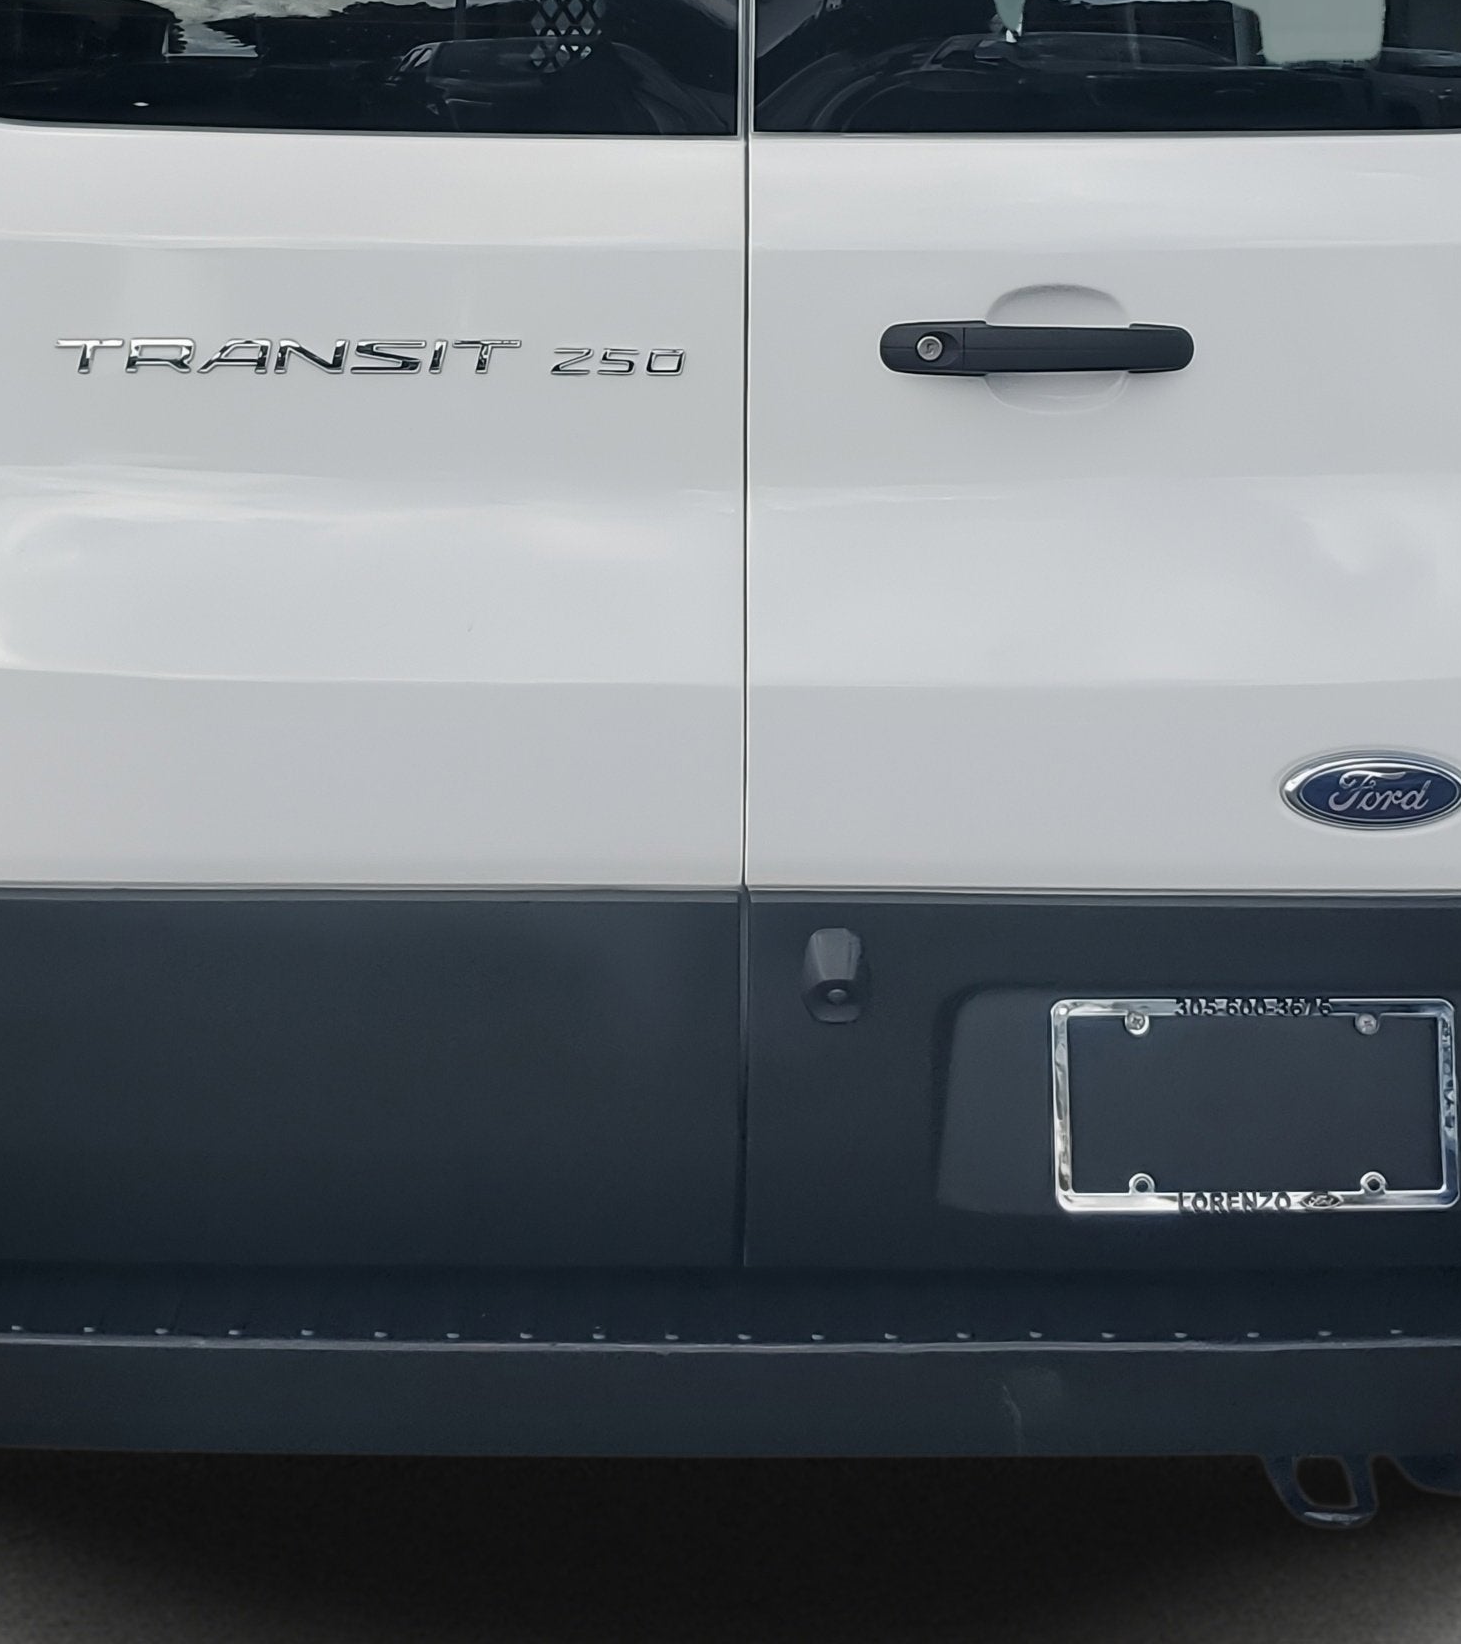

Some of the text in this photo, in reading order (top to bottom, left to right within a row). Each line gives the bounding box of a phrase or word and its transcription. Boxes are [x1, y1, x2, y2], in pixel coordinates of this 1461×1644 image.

[54, 337, 686, 377] TRANSIT 250
[1327, 769, 1432, 813] Ford
[1177, 1190, 1293, 1214] LORENZO
